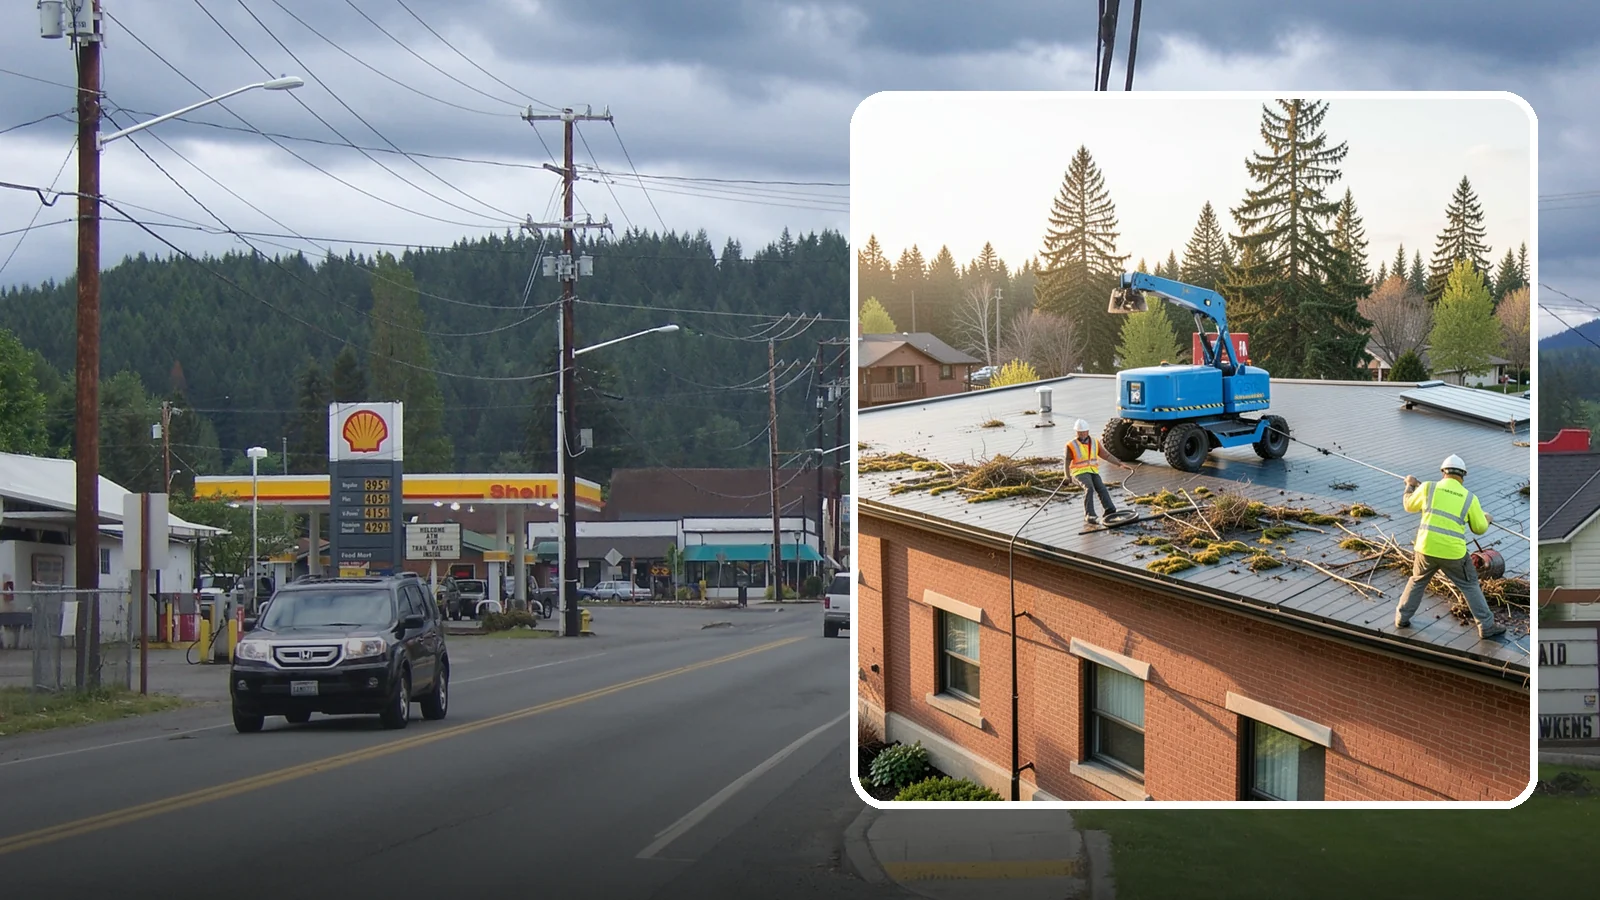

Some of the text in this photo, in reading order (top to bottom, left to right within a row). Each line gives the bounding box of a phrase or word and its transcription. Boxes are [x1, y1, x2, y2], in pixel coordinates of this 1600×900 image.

[366, 480, 383, 490] 395
[490, 484, 547, 499] Shell
[366, 494, 383, 504] 405
[366, 508, 383, 518] 415
[366, 522, 383, 532] 429
